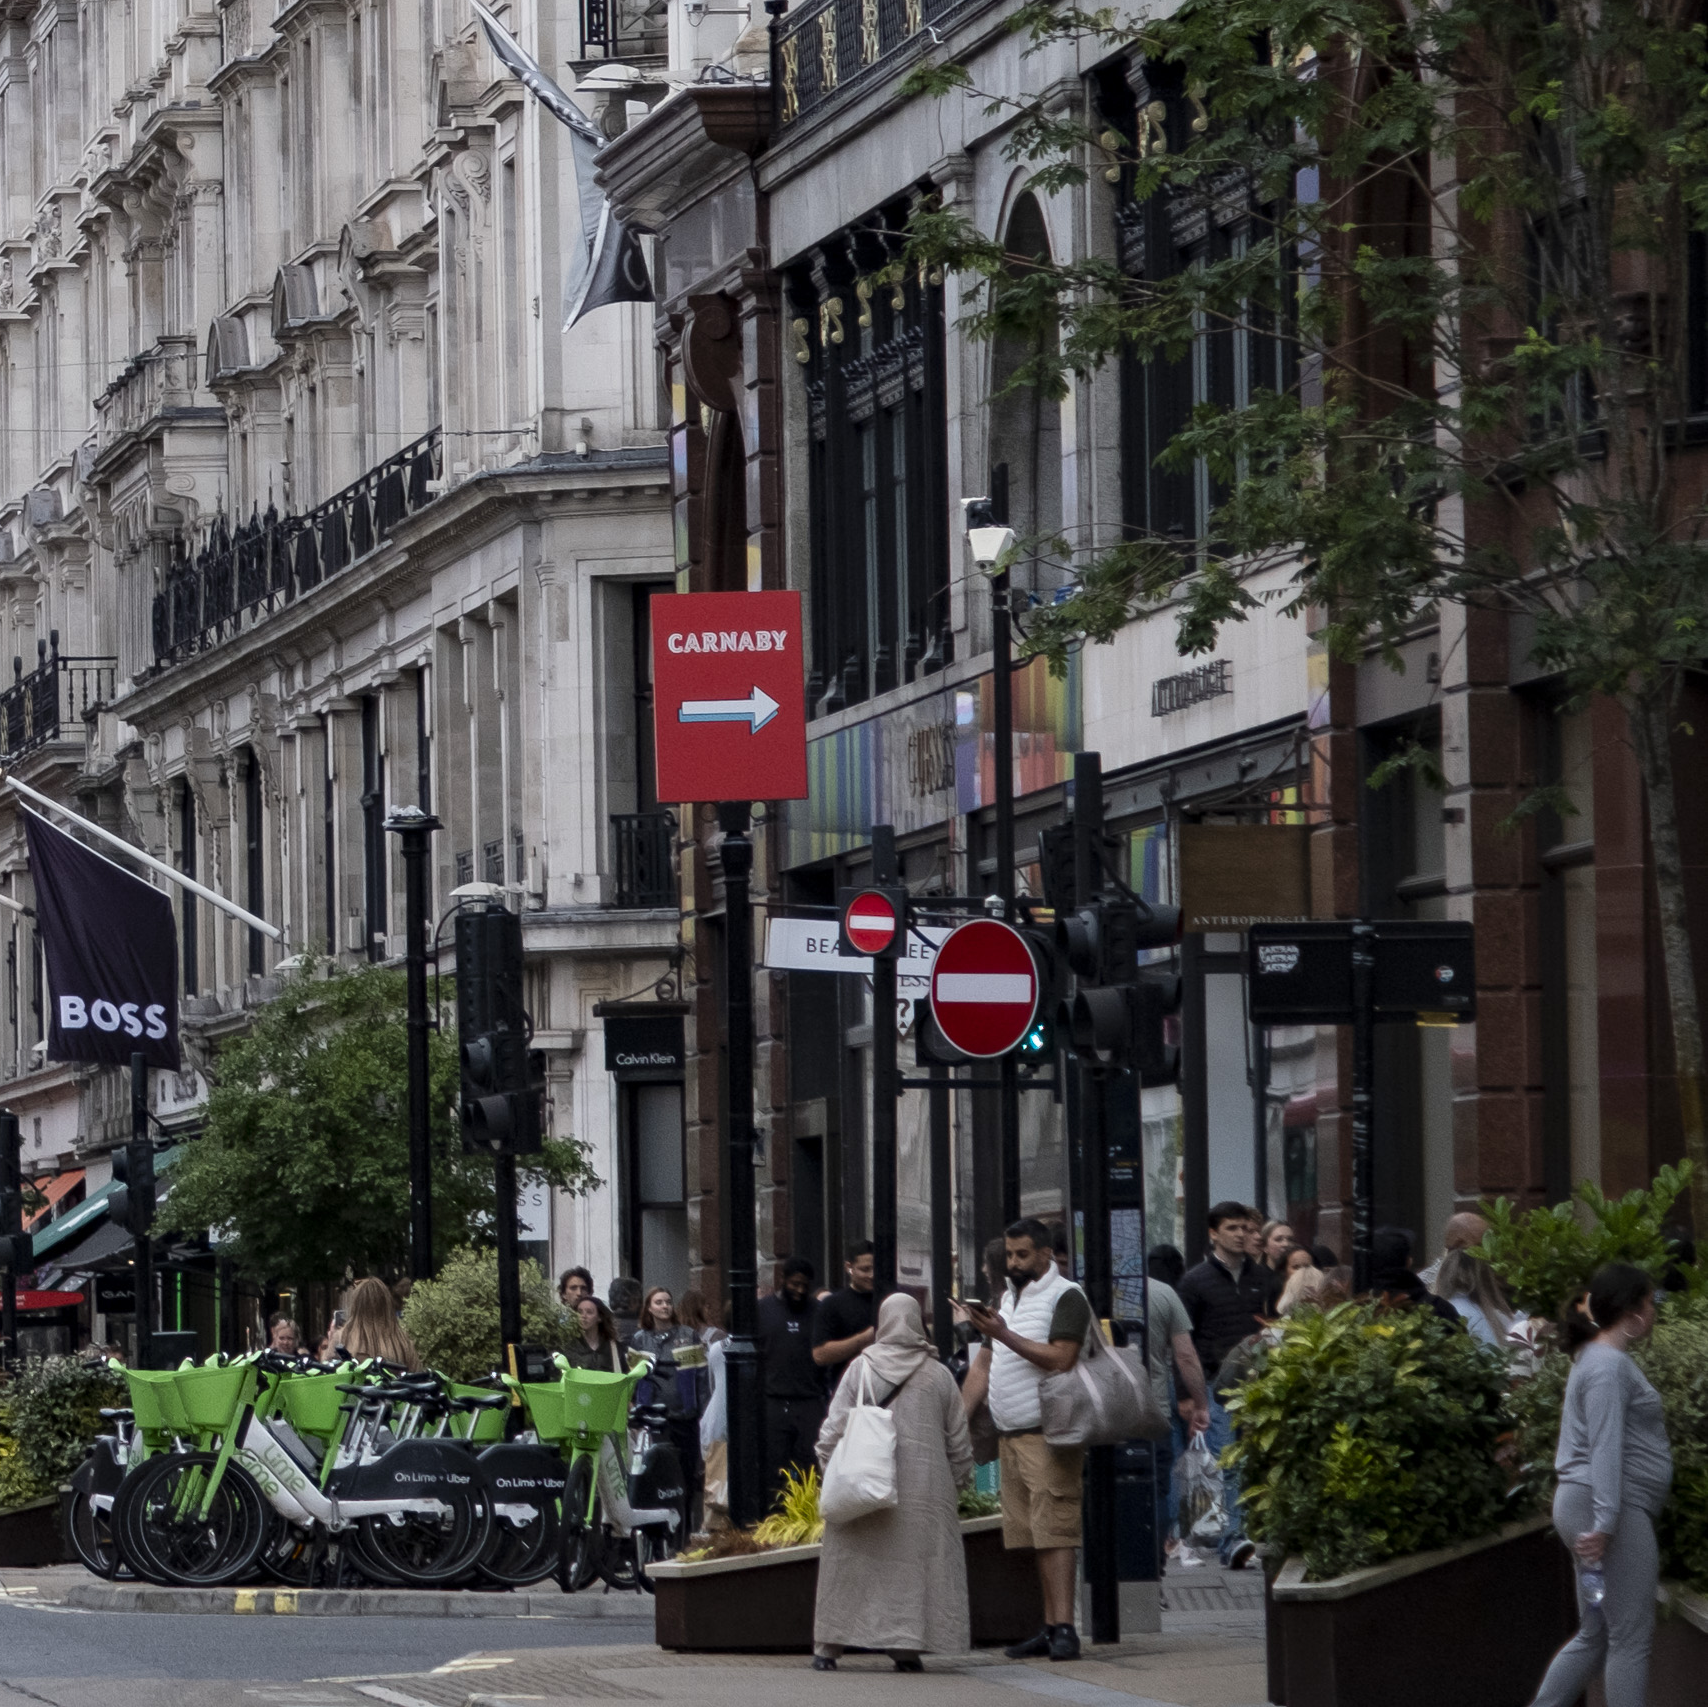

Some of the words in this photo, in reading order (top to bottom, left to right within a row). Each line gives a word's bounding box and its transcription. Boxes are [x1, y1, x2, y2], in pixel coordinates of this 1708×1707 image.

[667, 630, 788, 654] CARNABY
[59, 995, 167, 1040] BOSS
[616, 1053, 649, 1065] Calvin
[649, 1053, 676, 1064] Klein
[264, 1442, 305, 1493] Lime
[394, 1472, 411, 1482] On
[412, 1472, 437, 1483] Lime
[446, 1473, 471, 1484] Uber
[496, 1478, 512, 1488] On
[512, 1478, 536, 1487] Lime
[543, 1478, 566, 1488] Uber
